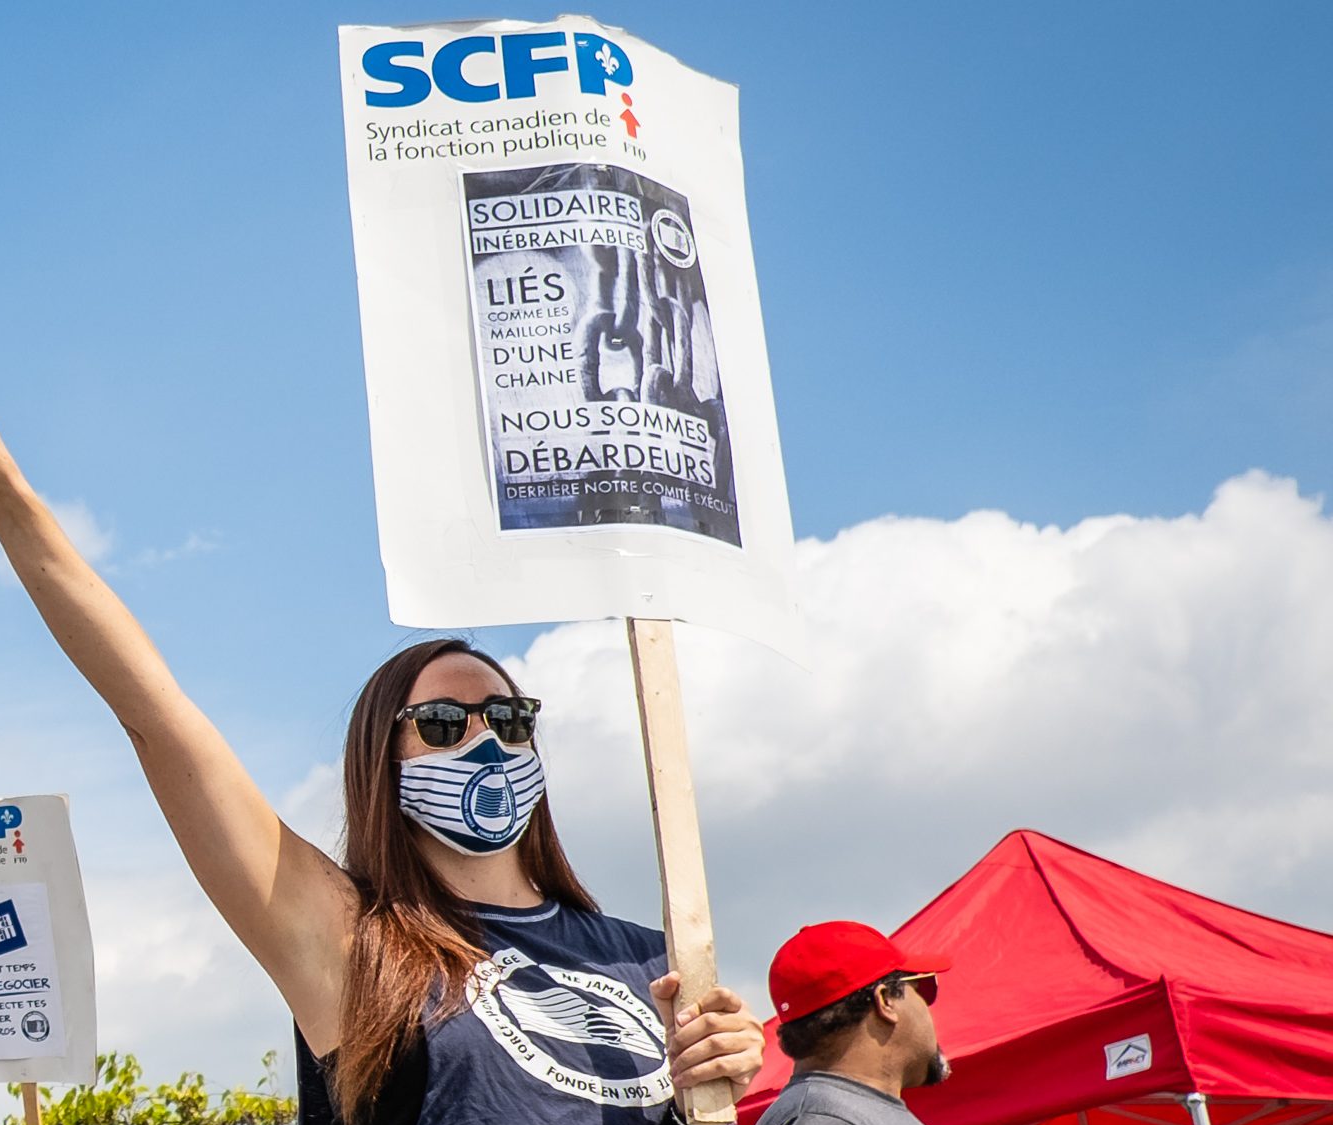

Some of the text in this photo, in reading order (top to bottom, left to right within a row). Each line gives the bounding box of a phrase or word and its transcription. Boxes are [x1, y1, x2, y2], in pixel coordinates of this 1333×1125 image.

[361, 31, 633, 108] SCFP
[365, 108, 611, 144] Syndicat canadien de
[368, 130, 608, 161] la fonction publique
[473, 194, 641, 225] SOLIDAIRES
[475, 226, 645, 254] INÉBRANLABLES
[487, 267, 566, 307] LIÉS
[488, 306, 569, 322] COMME LES
[490, 323, 572, 340] MAILLONS
[493, 341, 574, 366] D'UNE
[495, 368, 577, 390] CHAINE
[501, 405, 708, 444] NOUS SOMMES
[506, 441, 715, 485] DÉBARDEURS
[506, 481, 580, 499] DERRIÈRE
[585, 480, 638, 494] NOTRE
[642, 481, 691, 503] COMITÉ
[5, 963, 37, 972] TEMPS
[562, 973, 581, 983] NE
[26, 999, 47, 1008] TES
[545, 1066, 651, 1100] FONDÉ EN 1902
